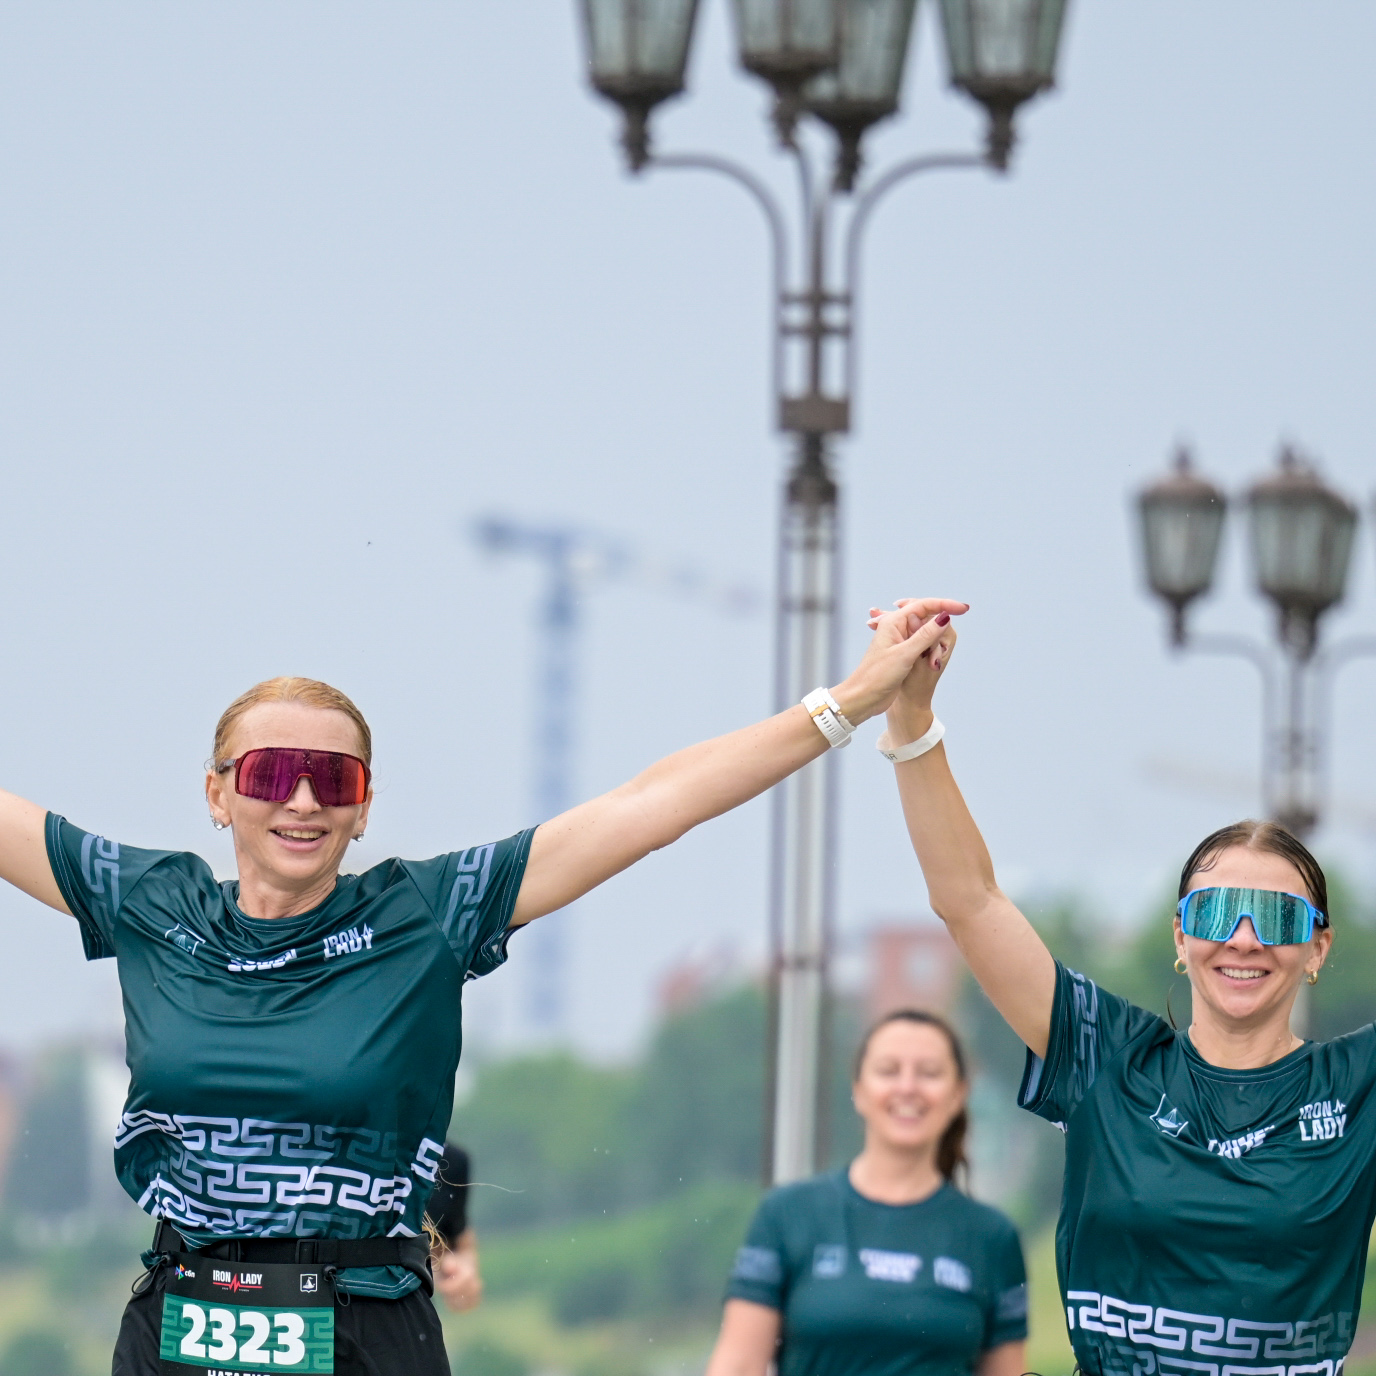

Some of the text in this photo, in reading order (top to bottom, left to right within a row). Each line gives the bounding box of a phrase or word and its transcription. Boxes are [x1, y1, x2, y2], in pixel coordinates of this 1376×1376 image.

[1299, 1101, 1333, 1120] IRON
[1299, 1114, 1347, 1141] LADY
[212, 1269, 263, 1285] IRON LADY
[180, 1303, 306, 1366] 2323
